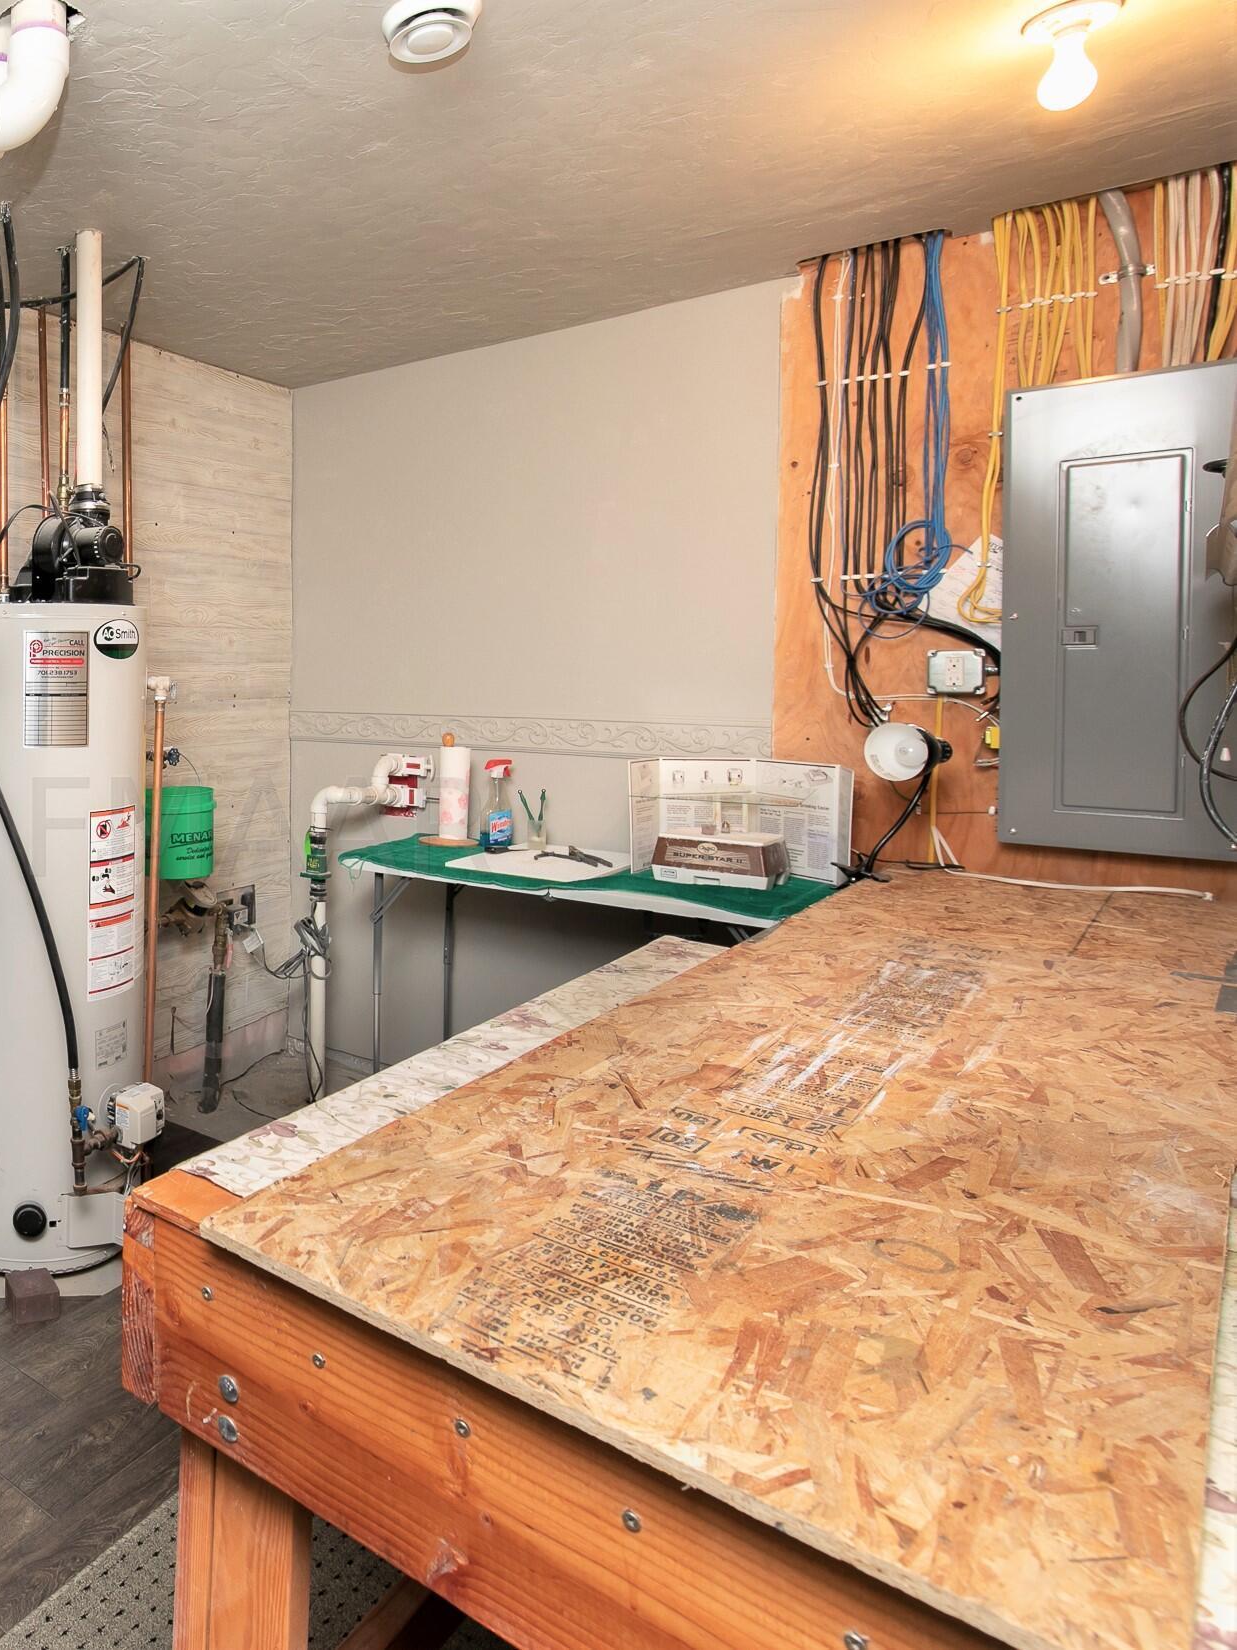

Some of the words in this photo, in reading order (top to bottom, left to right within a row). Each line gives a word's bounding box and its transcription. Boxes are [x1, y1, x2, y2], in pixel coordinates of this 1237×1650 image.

[116, 629, 136, 639] Smith
[42, 649, 85, 657] PRECISION
[673, 851, 705, 860] SUPER
[706, 855, 733, 863] STAR
